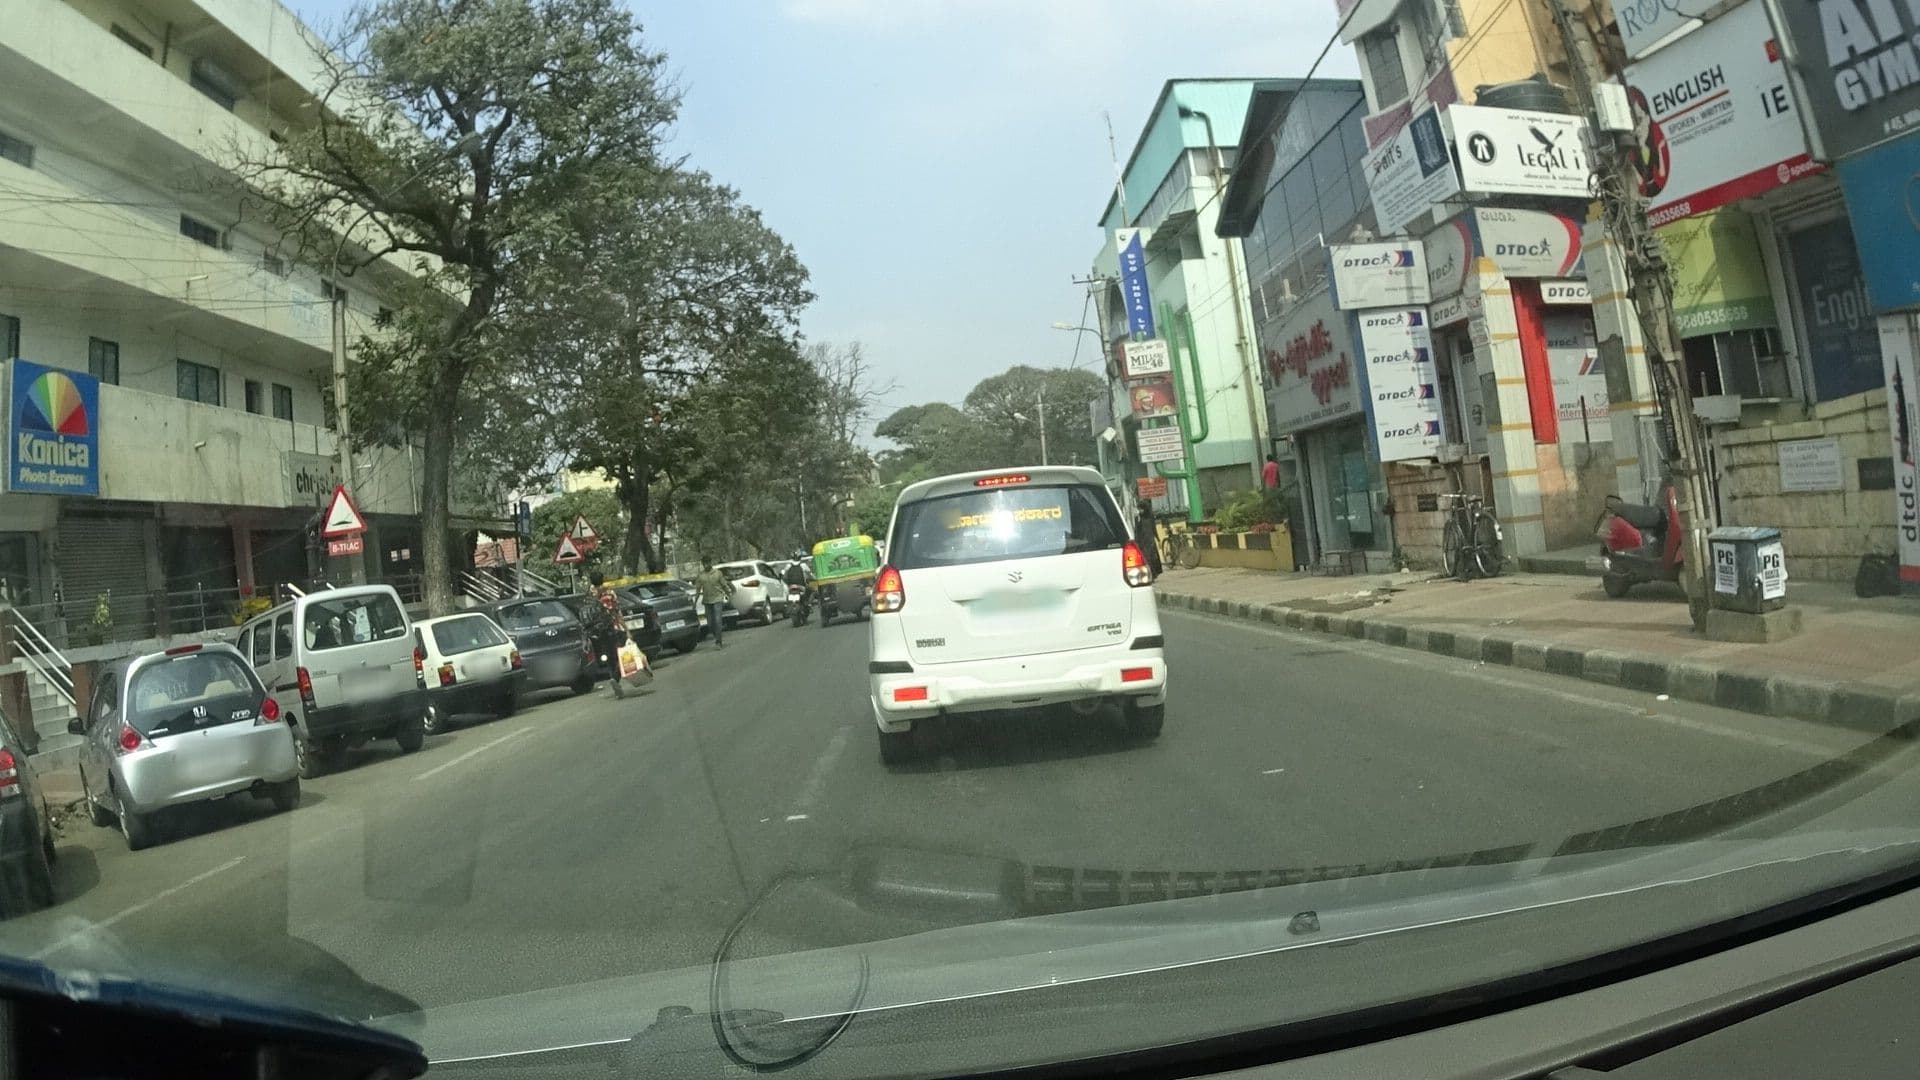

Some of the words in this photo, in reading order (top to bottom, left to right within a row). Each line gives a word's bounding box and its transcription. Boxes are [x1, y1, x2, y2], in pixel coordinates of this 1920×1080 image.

[1652, 64, 1725, 115] ENGLISH
[1701, 99, 1732, 119] WRITTEN
[1495, 243, 1539, 256] DTDC
[1344, 256, 1380, 268] DTDC
[1548, 286, 1586, 298] DTDC
[1367, 318, 1397, 327] DTDC
[1373, 354, 1403, 364] DTDC
[1379, 390, 1408, 401] DTDC
[1384, 427, 1413, 439] DTDC
[19, 432, 89, 468] Konica
[1717, 549, 1734, 566] PG
[1763, 553, 1780, 570] PG
